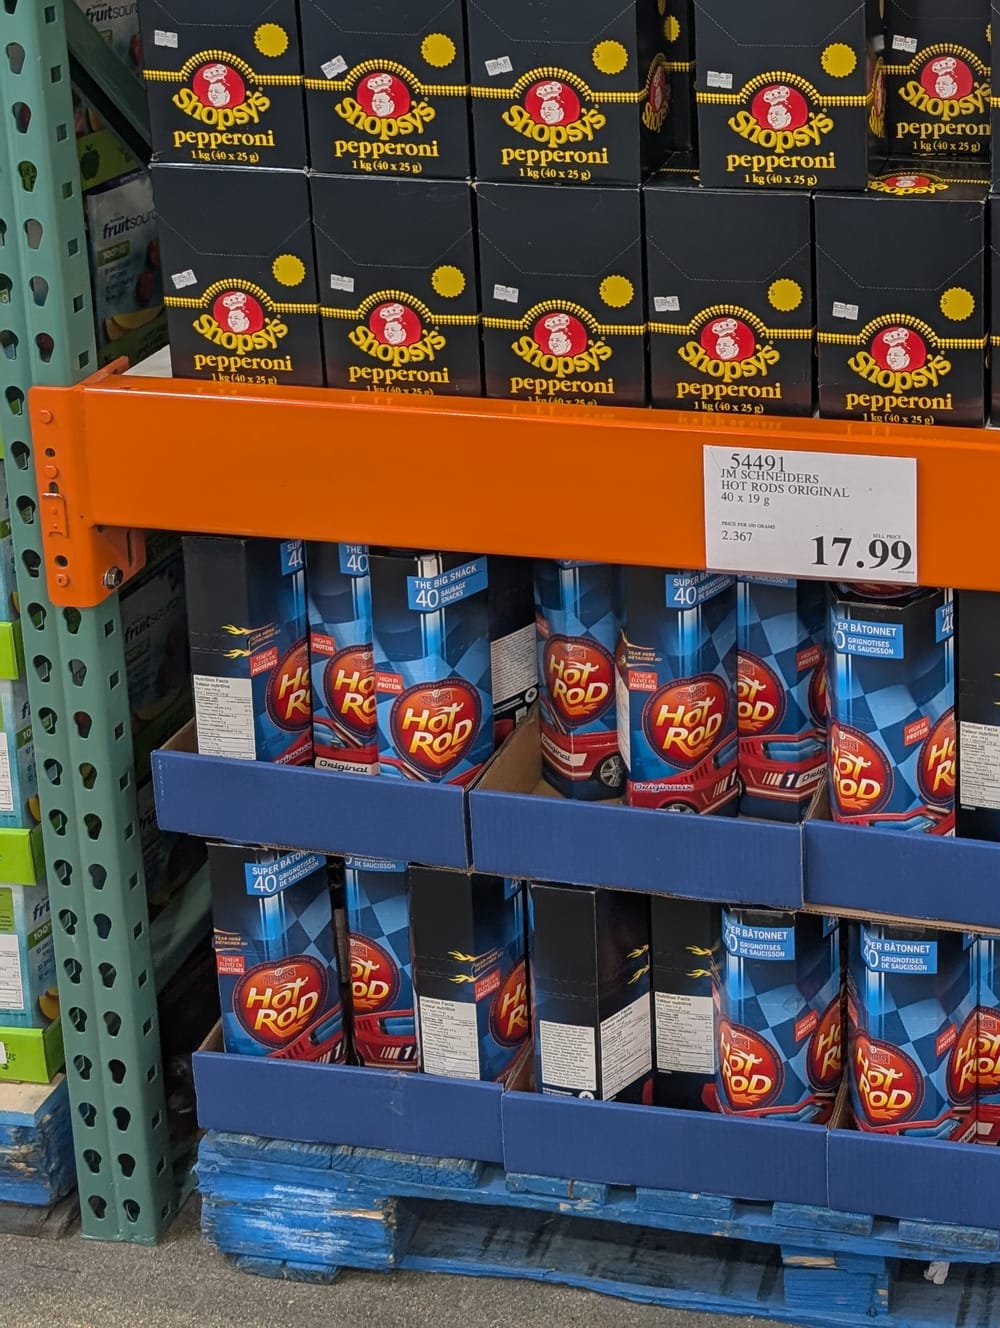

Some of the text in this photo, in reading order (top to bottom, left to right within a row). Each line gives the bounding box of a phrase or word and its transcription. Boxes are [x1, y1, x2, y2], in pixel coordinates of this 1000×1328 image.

[726, 152, 836, 172] pepperoni
[744, 174, 818, 186] 1 kg (40 x 25 g)
[730, 453, 785, 472] 54491
[721, 469, 819, 484] JM SCHNEIDERS
[721, 481, 849, 498] HOT RODS ORIGINAL
[721, 493, 734, 502] 40
[749, 494, 760, 503] 19
[764, 496, 770, 506] g
[721, 530, 752, 542] 2.367
[811, 536, 911, 571] 17.99
[415, 563, 477, 590] THE BIG SNACK
[415, 590, 439, 608] 40
[377, 682, 401, 690] PROTEIN
[319, 759, 368, 773] Original
